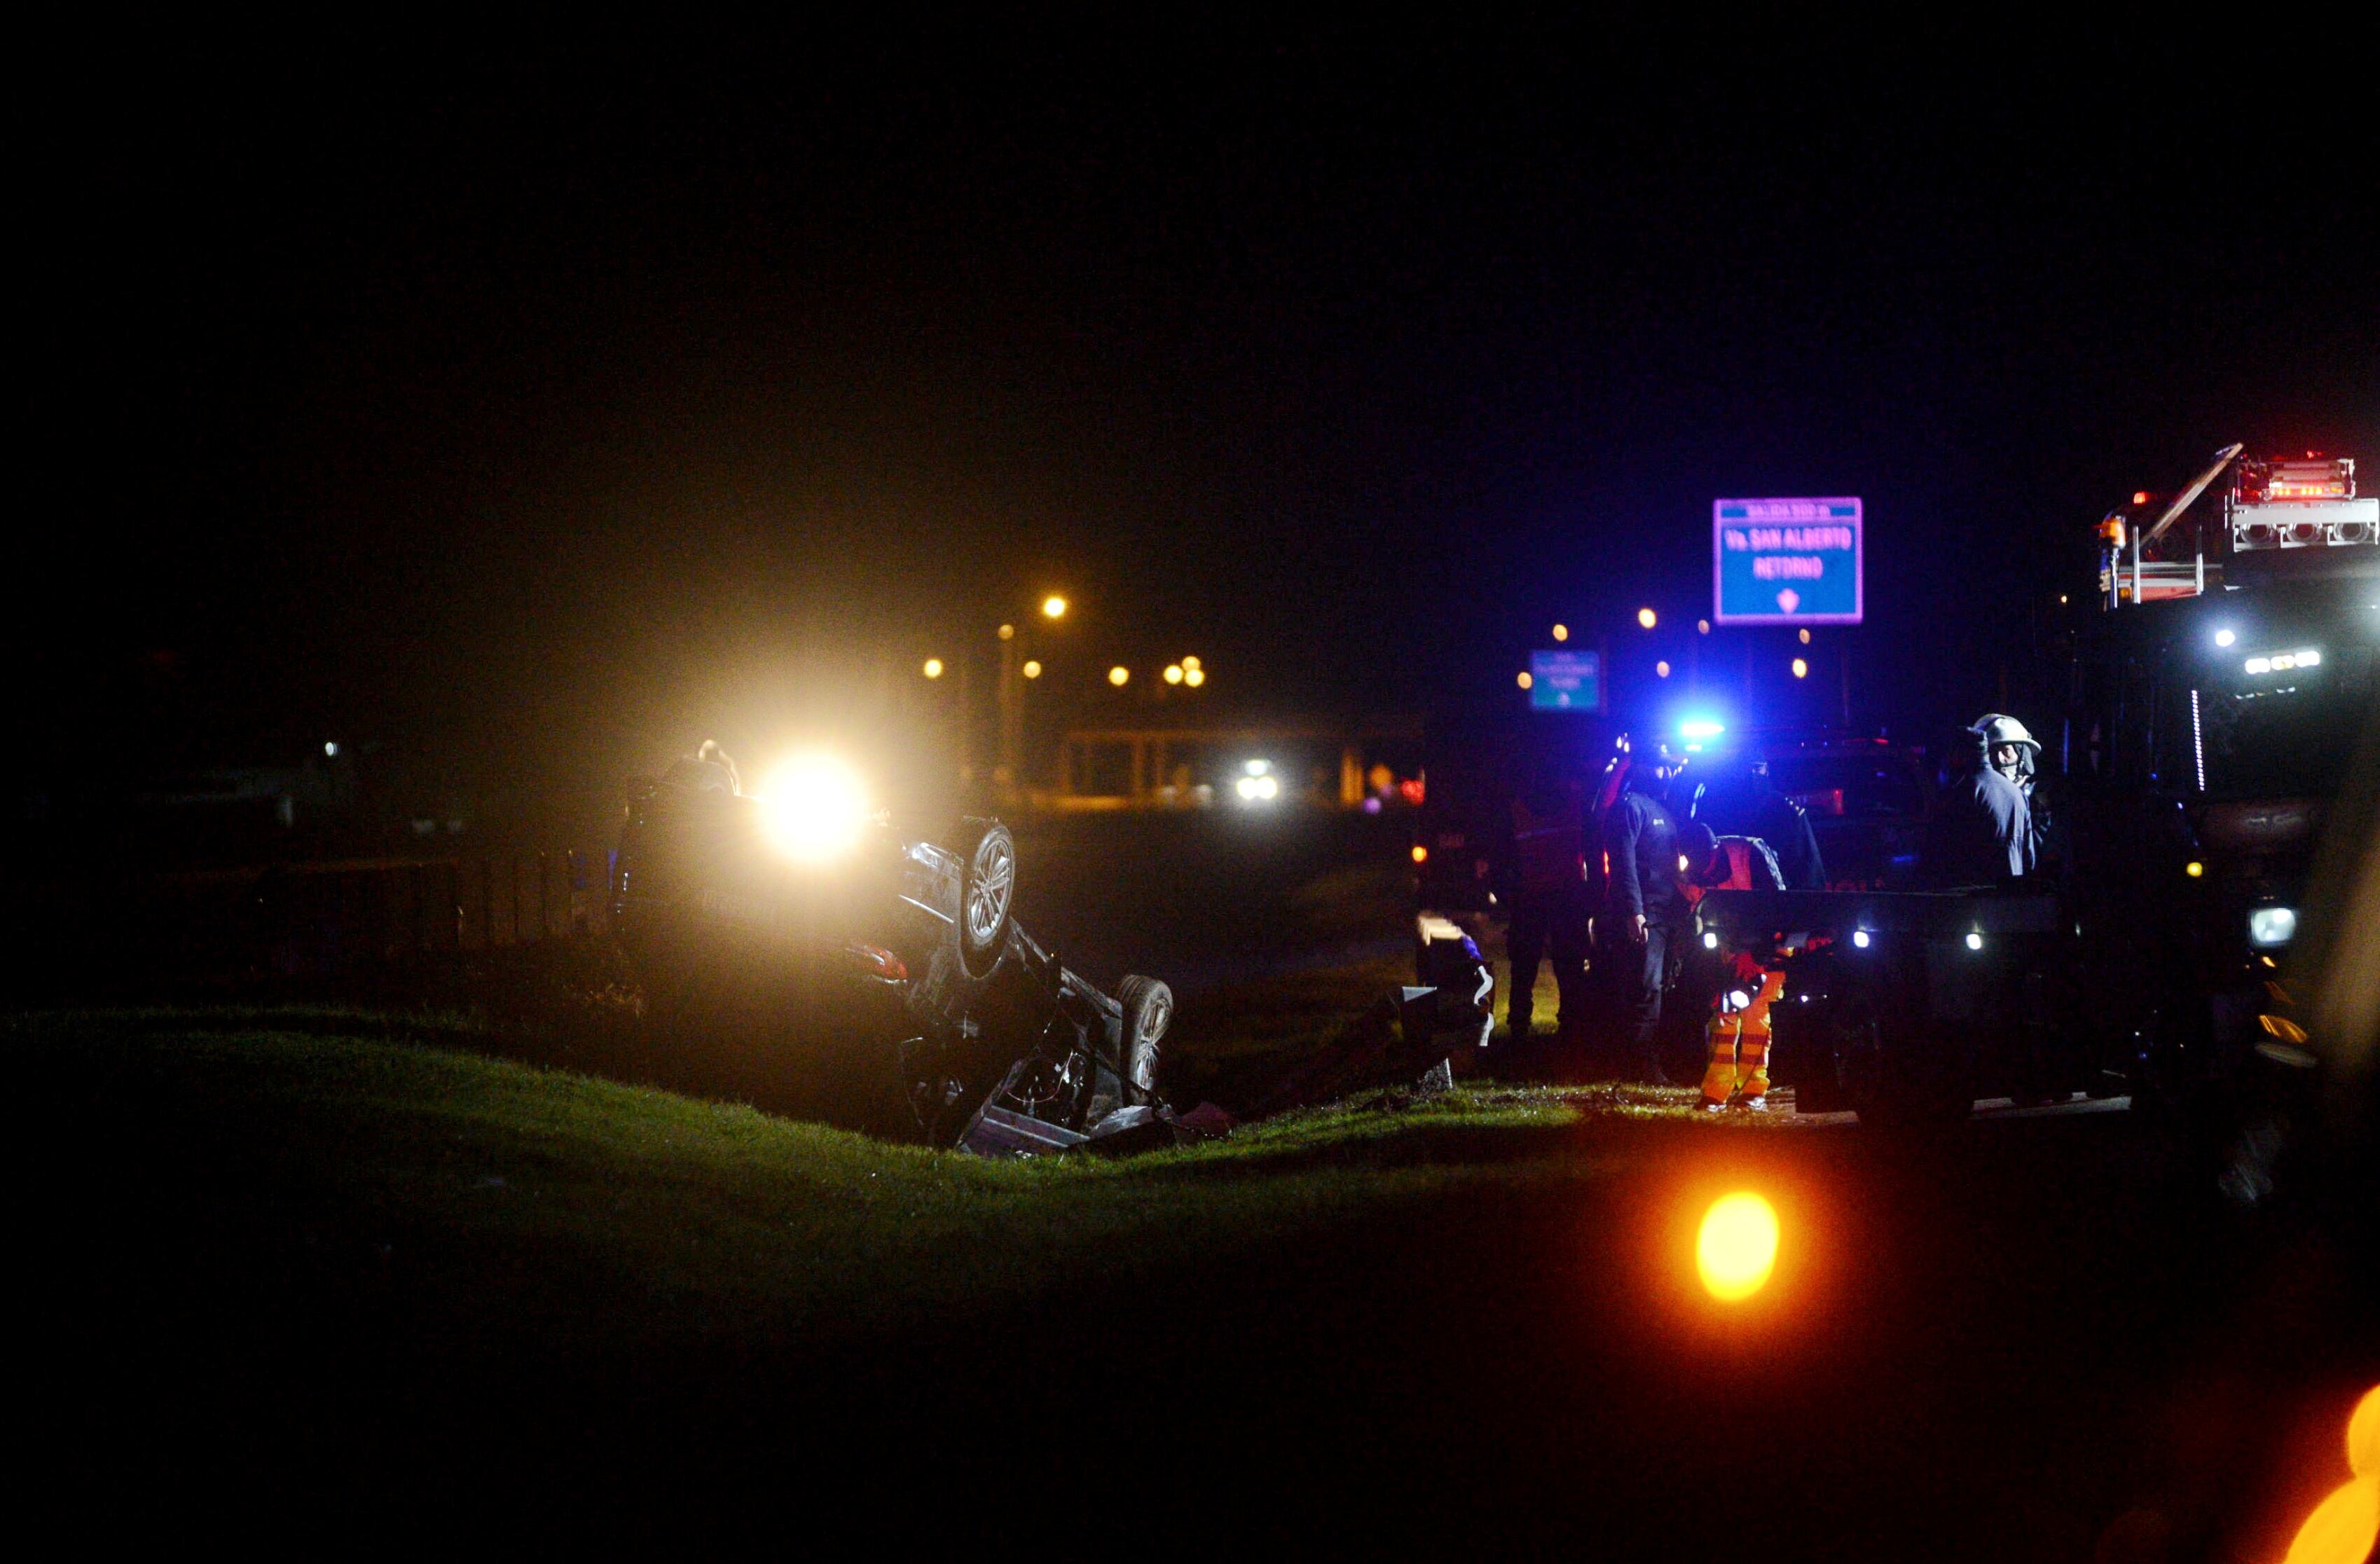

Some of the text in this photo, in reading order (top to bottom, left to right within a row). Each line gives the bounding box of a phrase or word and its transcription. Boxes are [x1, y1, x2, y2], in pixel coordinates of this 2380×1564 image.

[1749, 528, 1782, 551] SAN
[1784, 527, 1852, 551] ALBERTO
[1753, 556, 1823, 580] RETORNO
